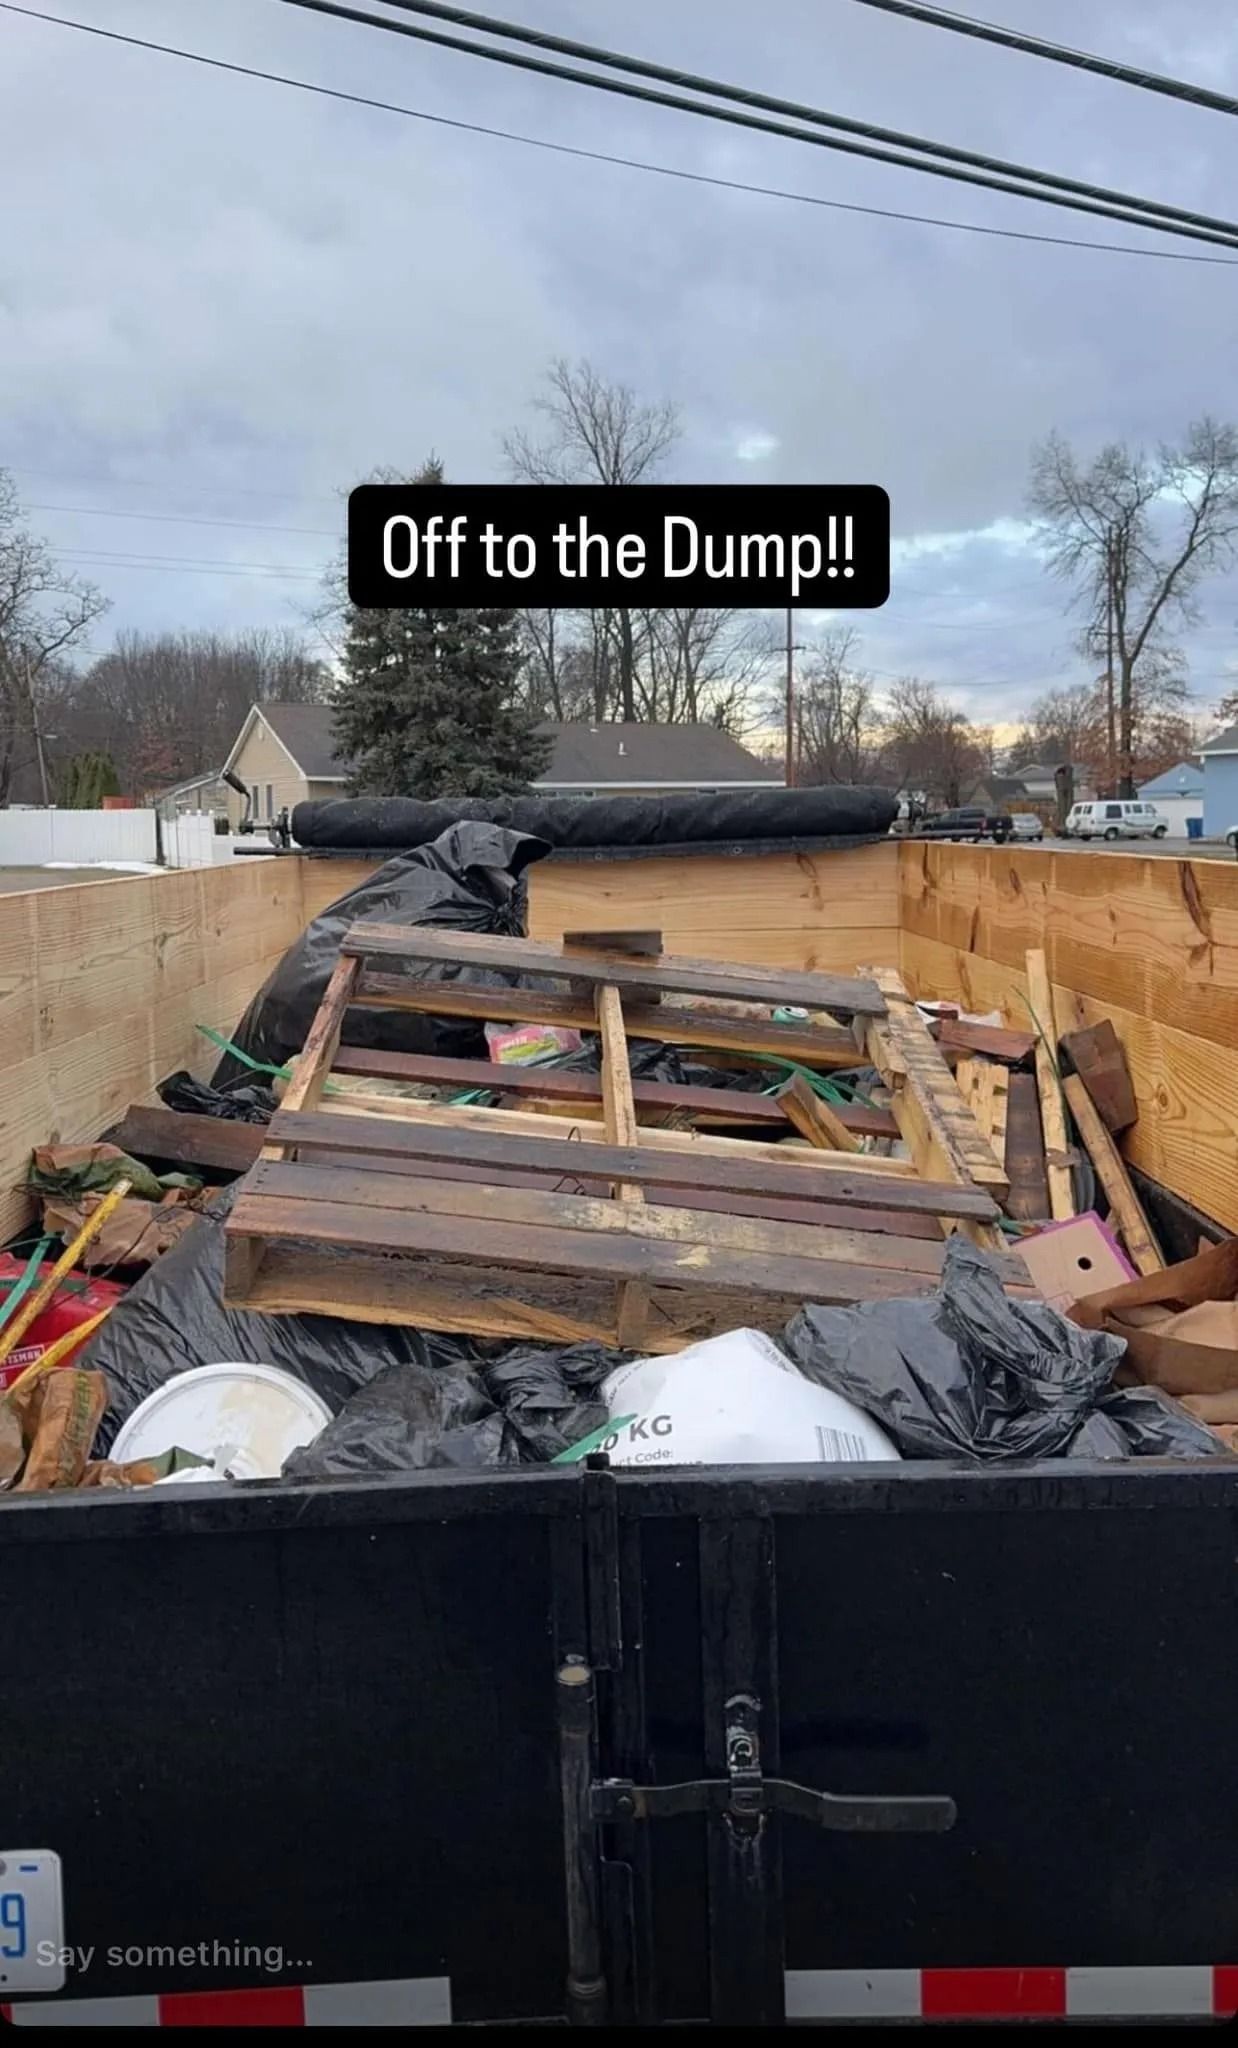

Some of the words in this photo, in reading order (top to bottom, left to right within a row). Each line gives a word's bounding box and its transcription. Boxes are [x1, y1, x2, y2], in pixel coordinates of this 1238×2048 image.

[629, 1415, 672, 1442] KG
[635, 1448, 673, 1463] Code:
[1, 1893, 26, 1958] 9
